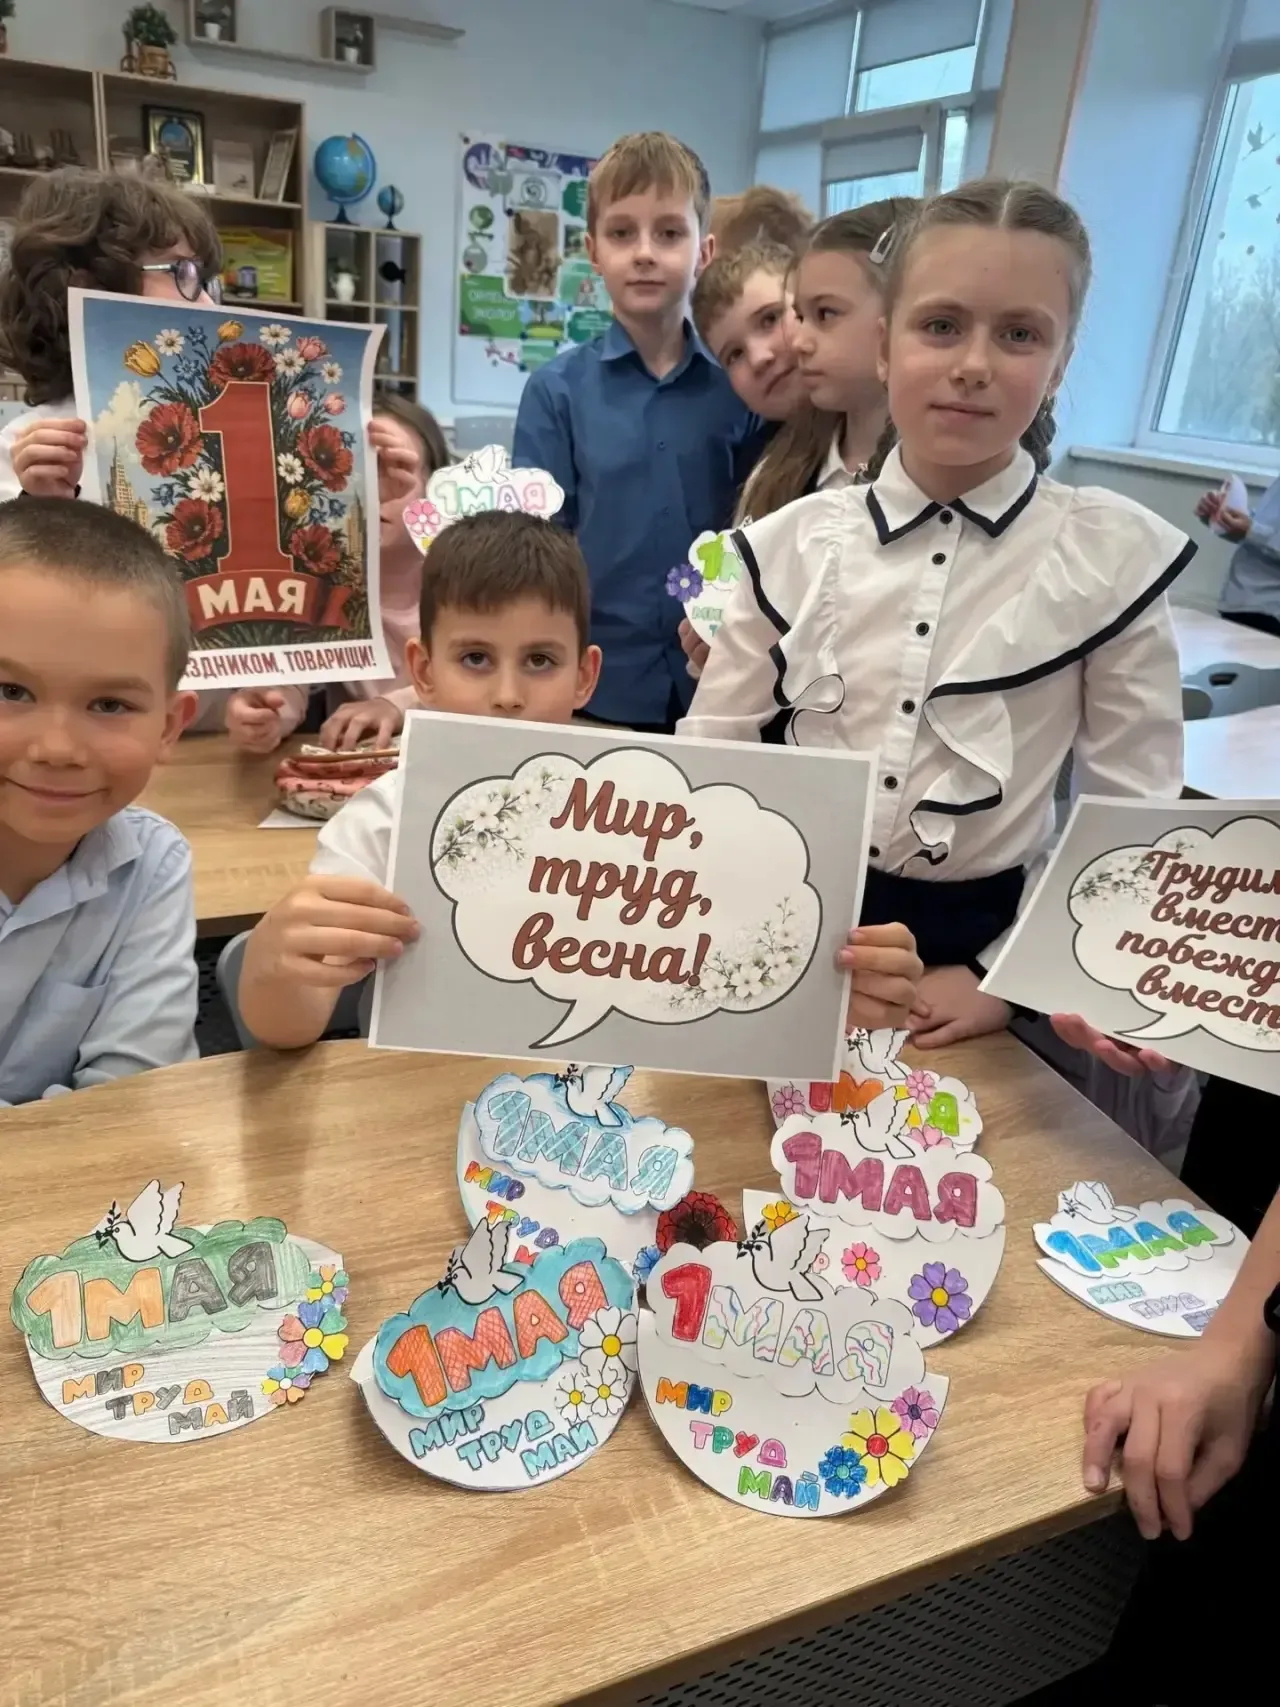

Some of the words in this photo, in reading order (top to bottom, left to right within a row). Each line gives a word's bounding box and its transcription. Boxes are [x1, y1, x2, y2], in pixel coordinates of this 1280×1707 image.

[198, 380, 294, 572] 1
[196, 577, 308, 620] МАЯ
[283, 645, 377, 673] ТОВАРИЩИ!
[550, 777, 703, 861] Мир,
[529, 855, 712, 929] труд,
[511, 911, 712, 986] весна!
[464, 1160, 525, 1201] МИР
[1086, 1280, 1144, 1305] МИР
[1128, 1292, 1206, 1320] ТРУД
[62, 1363, 145, 1405] МИР
[106, 1379, 215, 1421] ТРУД
[655, 1376, 733, 1417] МИР
[168, 1389, 255, 1436] МАЙ
[408, 1403, 486, 1459] МИР
[456, 1410, 555, 1470] ТРУД
[689, 1420, 788, 1469] ТРУД
[737, 1465, 821, 1512] МАЙ
